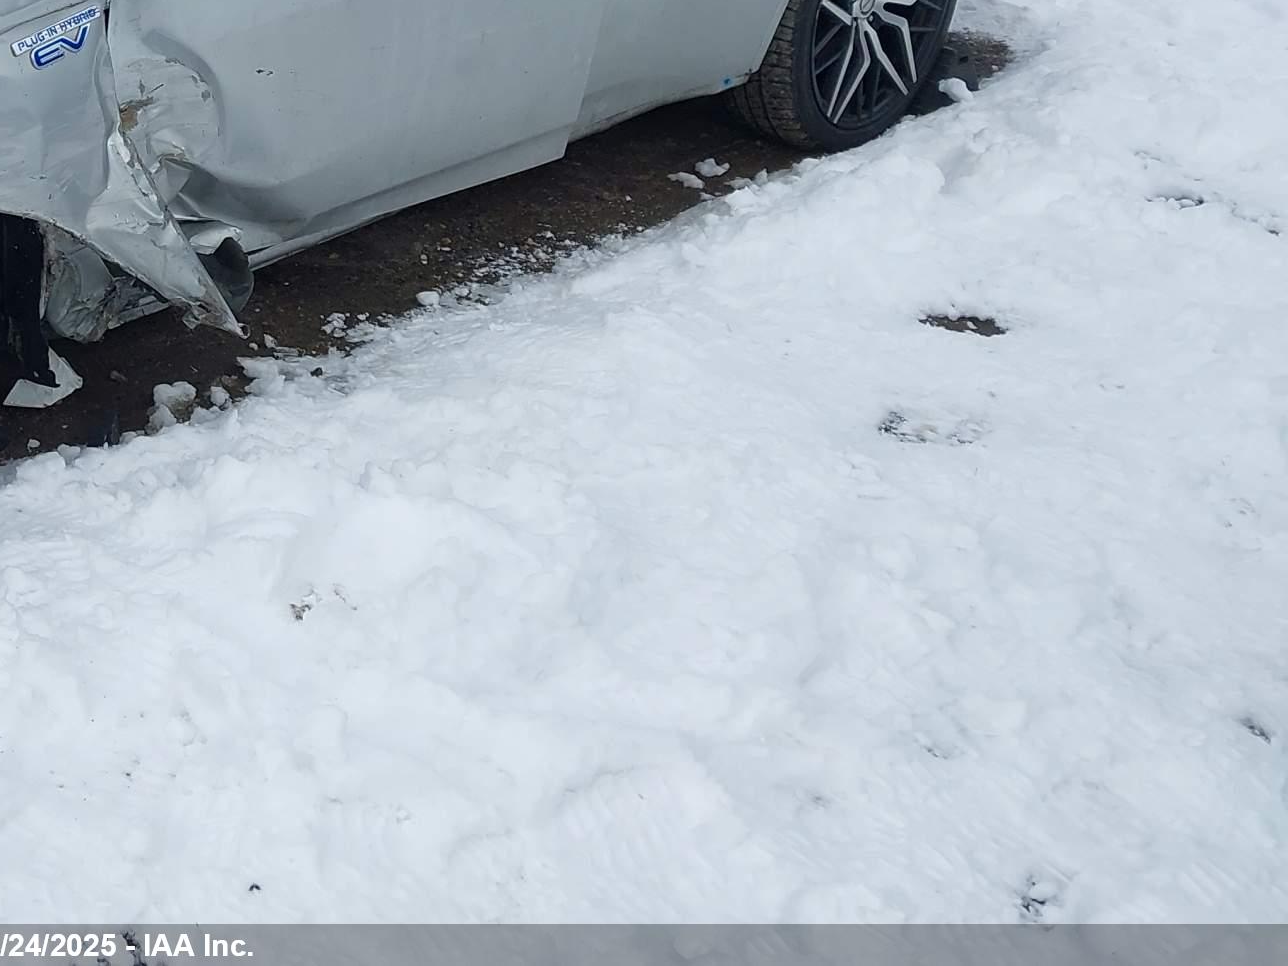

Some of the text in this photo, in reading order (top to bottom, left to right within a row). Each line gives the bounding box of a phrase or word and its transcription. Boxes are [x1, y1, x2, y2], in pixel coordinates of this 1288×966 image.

[17, 8, 98, 52] PLUG-IN HYBRID
[33, 24, 89, 67] EV
